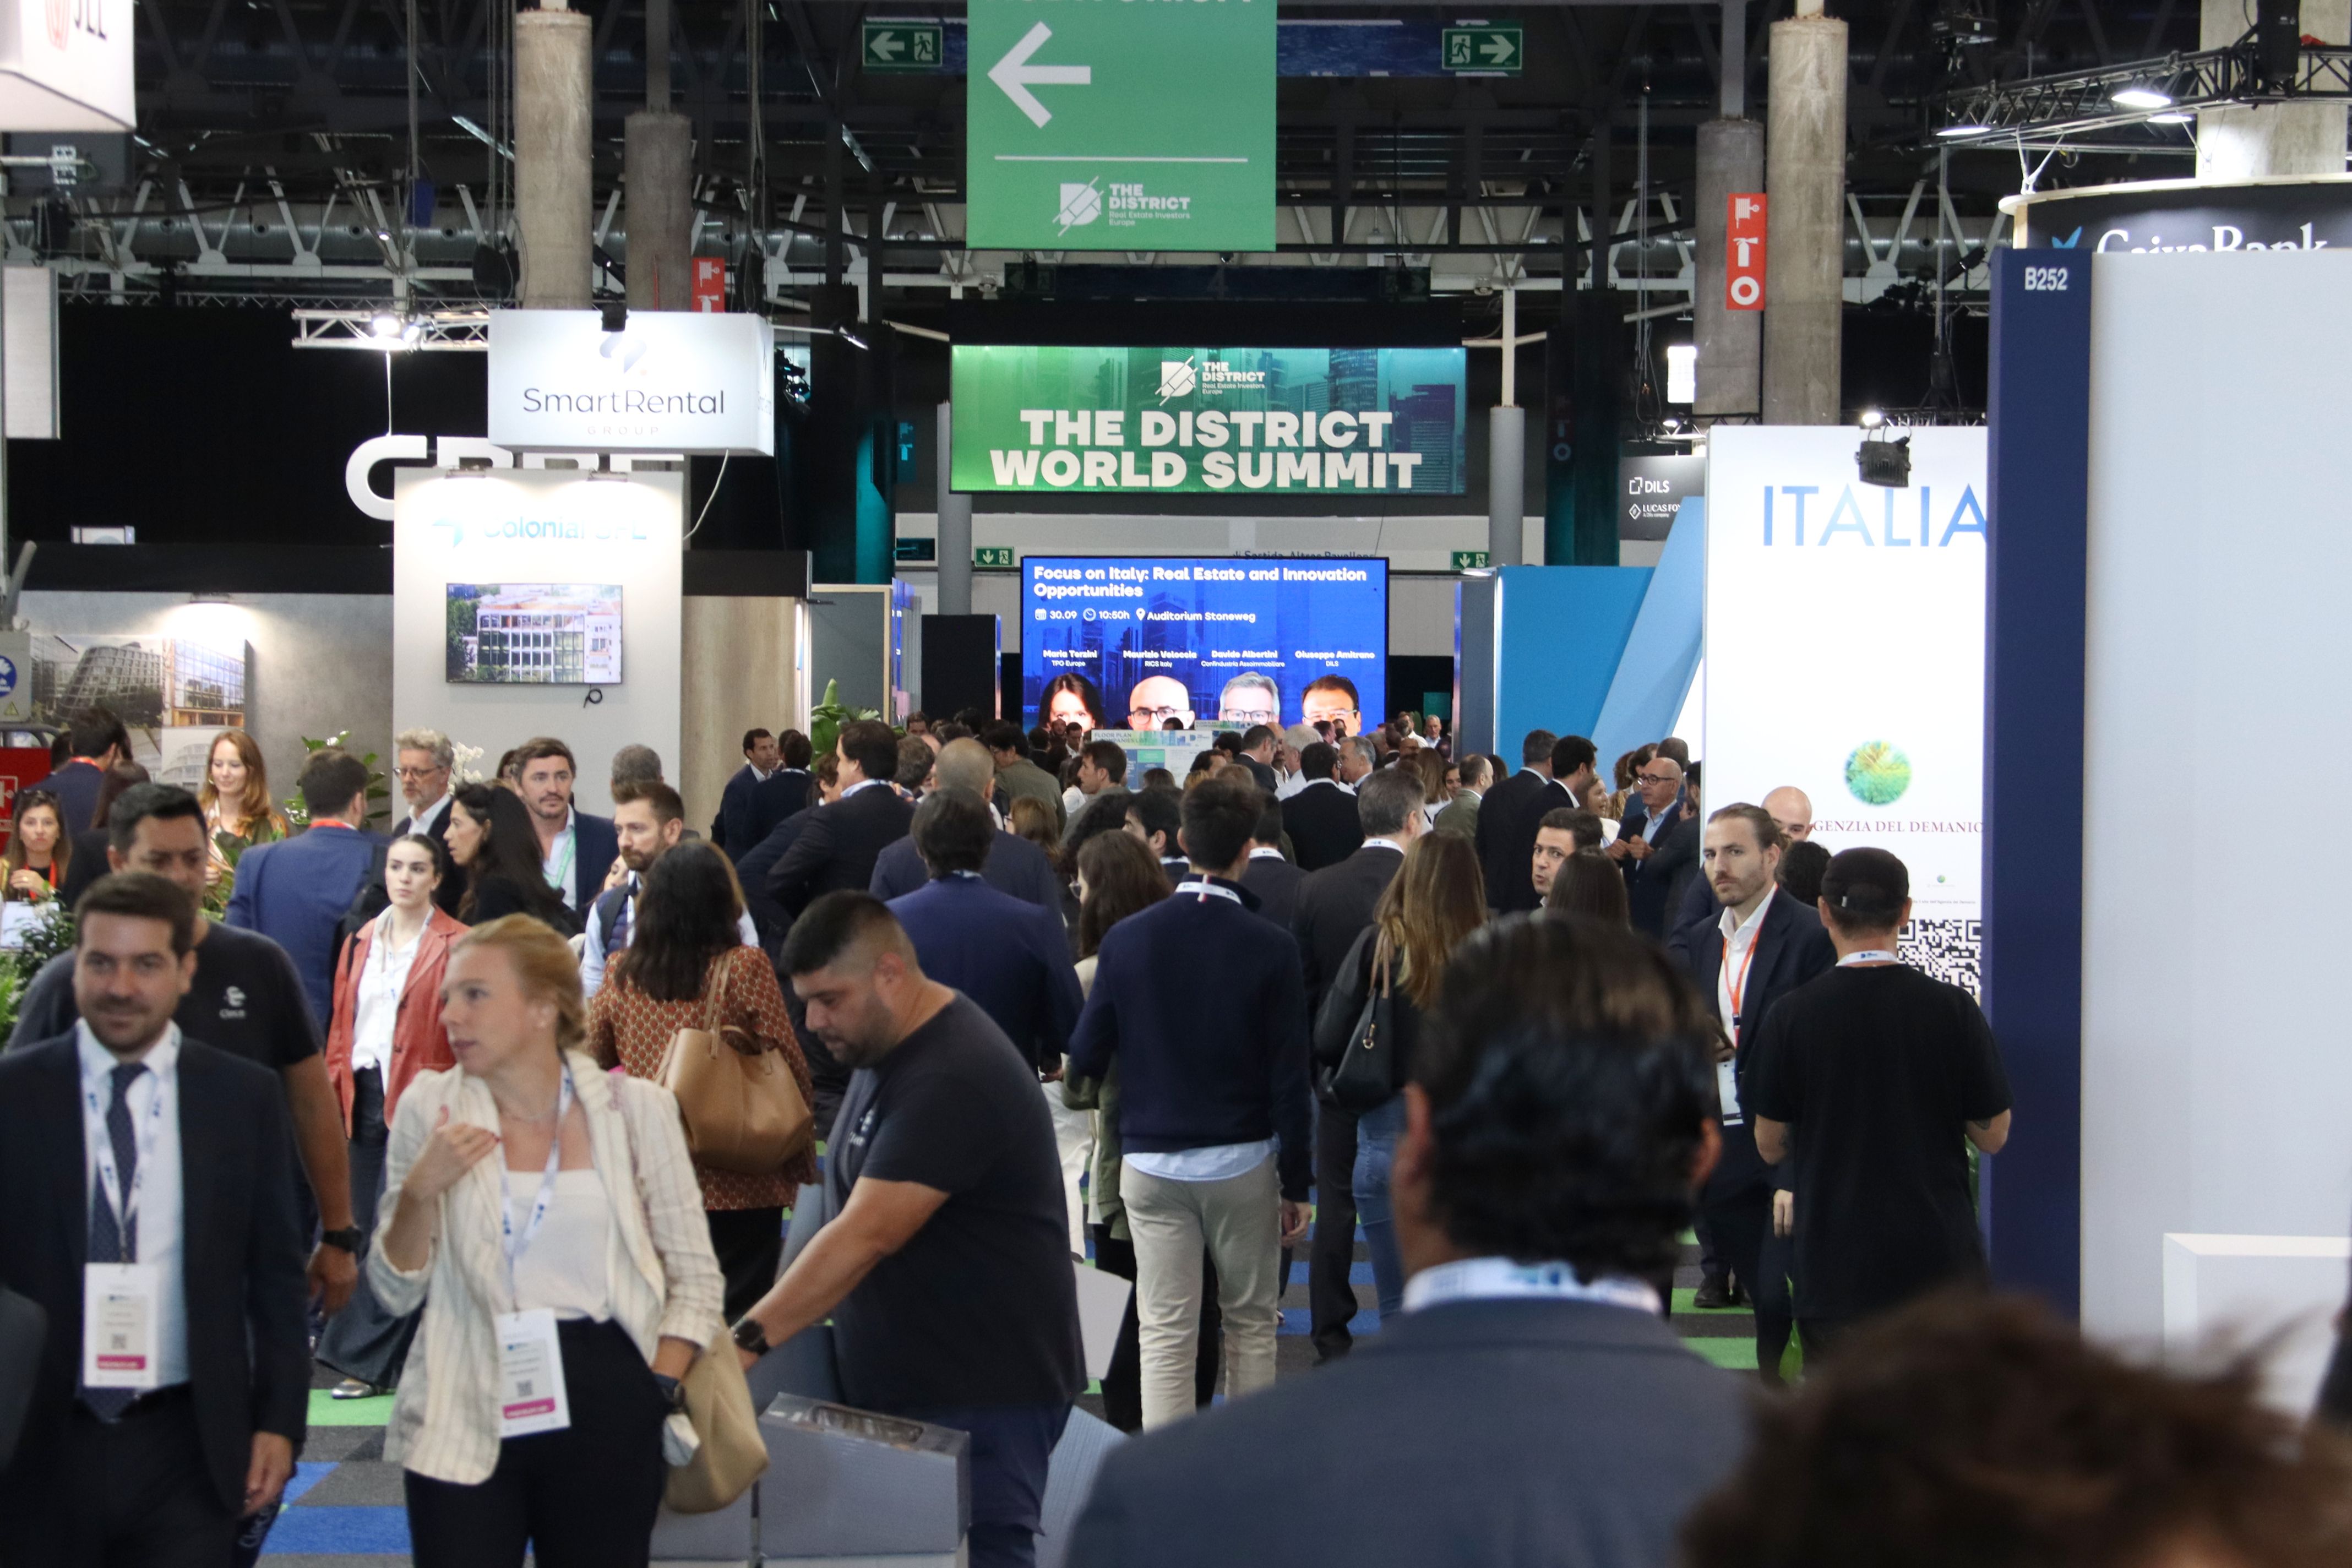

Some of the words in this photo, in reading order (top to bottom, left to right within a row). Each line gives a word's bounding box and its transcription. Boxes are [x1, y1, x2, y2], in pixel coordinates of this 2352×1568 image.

[1109, 183, 1143, 197] THE
[1109, 197, 1190, 210] DISTRICT
[2024, 266, 2068, 291] B252
[1202, 362, 1229, 372] THE
[1202, 372, 1265, 382] DISTRICT
[523, 388, 724, 414] SmartRental
[587, 426, 660, 435] GROUP
[1020, 410, 1124, 446] THE
[1141, 410, 1392, 448] DISTRICT
[989, 449, 1187, 487] WORLD
[1201, 450, 1422, 489] SUMMIT
[1645, 480, 1670, 493] DILS
[1642, 504, 1667, 512] LUCAS
[1034, 566, 1081, 580] Focus
[1085, 569, 1106, 580] on
[1109, 567, 1149, 582] Italy:
[1153, 567, 1190, 580] Real
[1194, 567, 1245, 580] Estate
[1249, 567, 1279, 581] and
[1283, 567, 1367, 581] Innovation
[1033, 582, 1144, 599] Opportunities
[1049, 610, 1077, 620] 30.09
[1098, 610, 1130, 620] 10:50h
[1147, 611, 1202, 621] Auditorium
[1204, 612, 1256, 623] Stoneweg
[1043, 650, 1068, 658] Maria
[1069, 650, 1097, 658] Terzini
[1123, 650, 1159, 658] Maurizio
[1211, 650, 1240, 658] Davide
[1242, 650, 1278, 658] Albertini
[1295, 651, 1335, 660] Giuseppe
[1336, 651, 1375, 659] Amitrano
[1812, 820, 1871, 832] GENZIA
[1876, 821, 1905, 832] DEL
